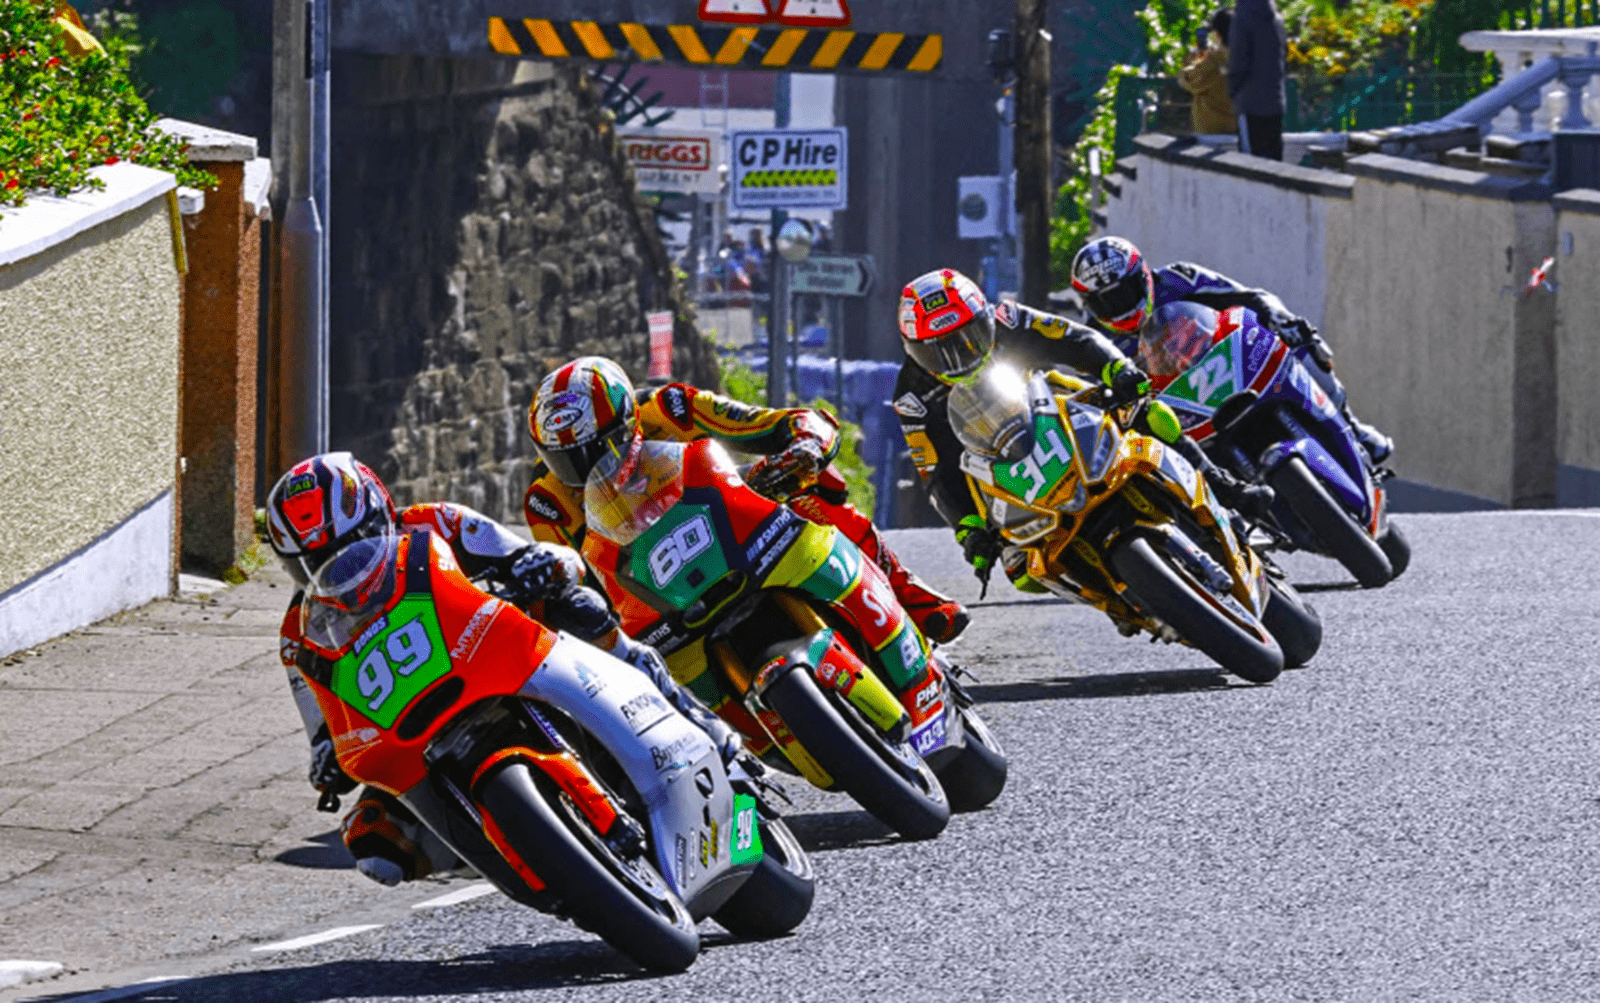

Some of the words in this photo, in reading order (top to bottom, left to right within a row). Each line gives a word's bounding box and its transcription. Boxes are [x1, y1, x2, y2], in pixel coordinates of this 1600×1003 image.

[627, 143, 702, 164] RIGGS
[783, 138, 837, 166] Hire
[1188, 354, 1233, 404] 22
[1009, 429, 1072, 504] 34
[649, 514, 714, 589] 60
[356, 612, 433, 713] 99
